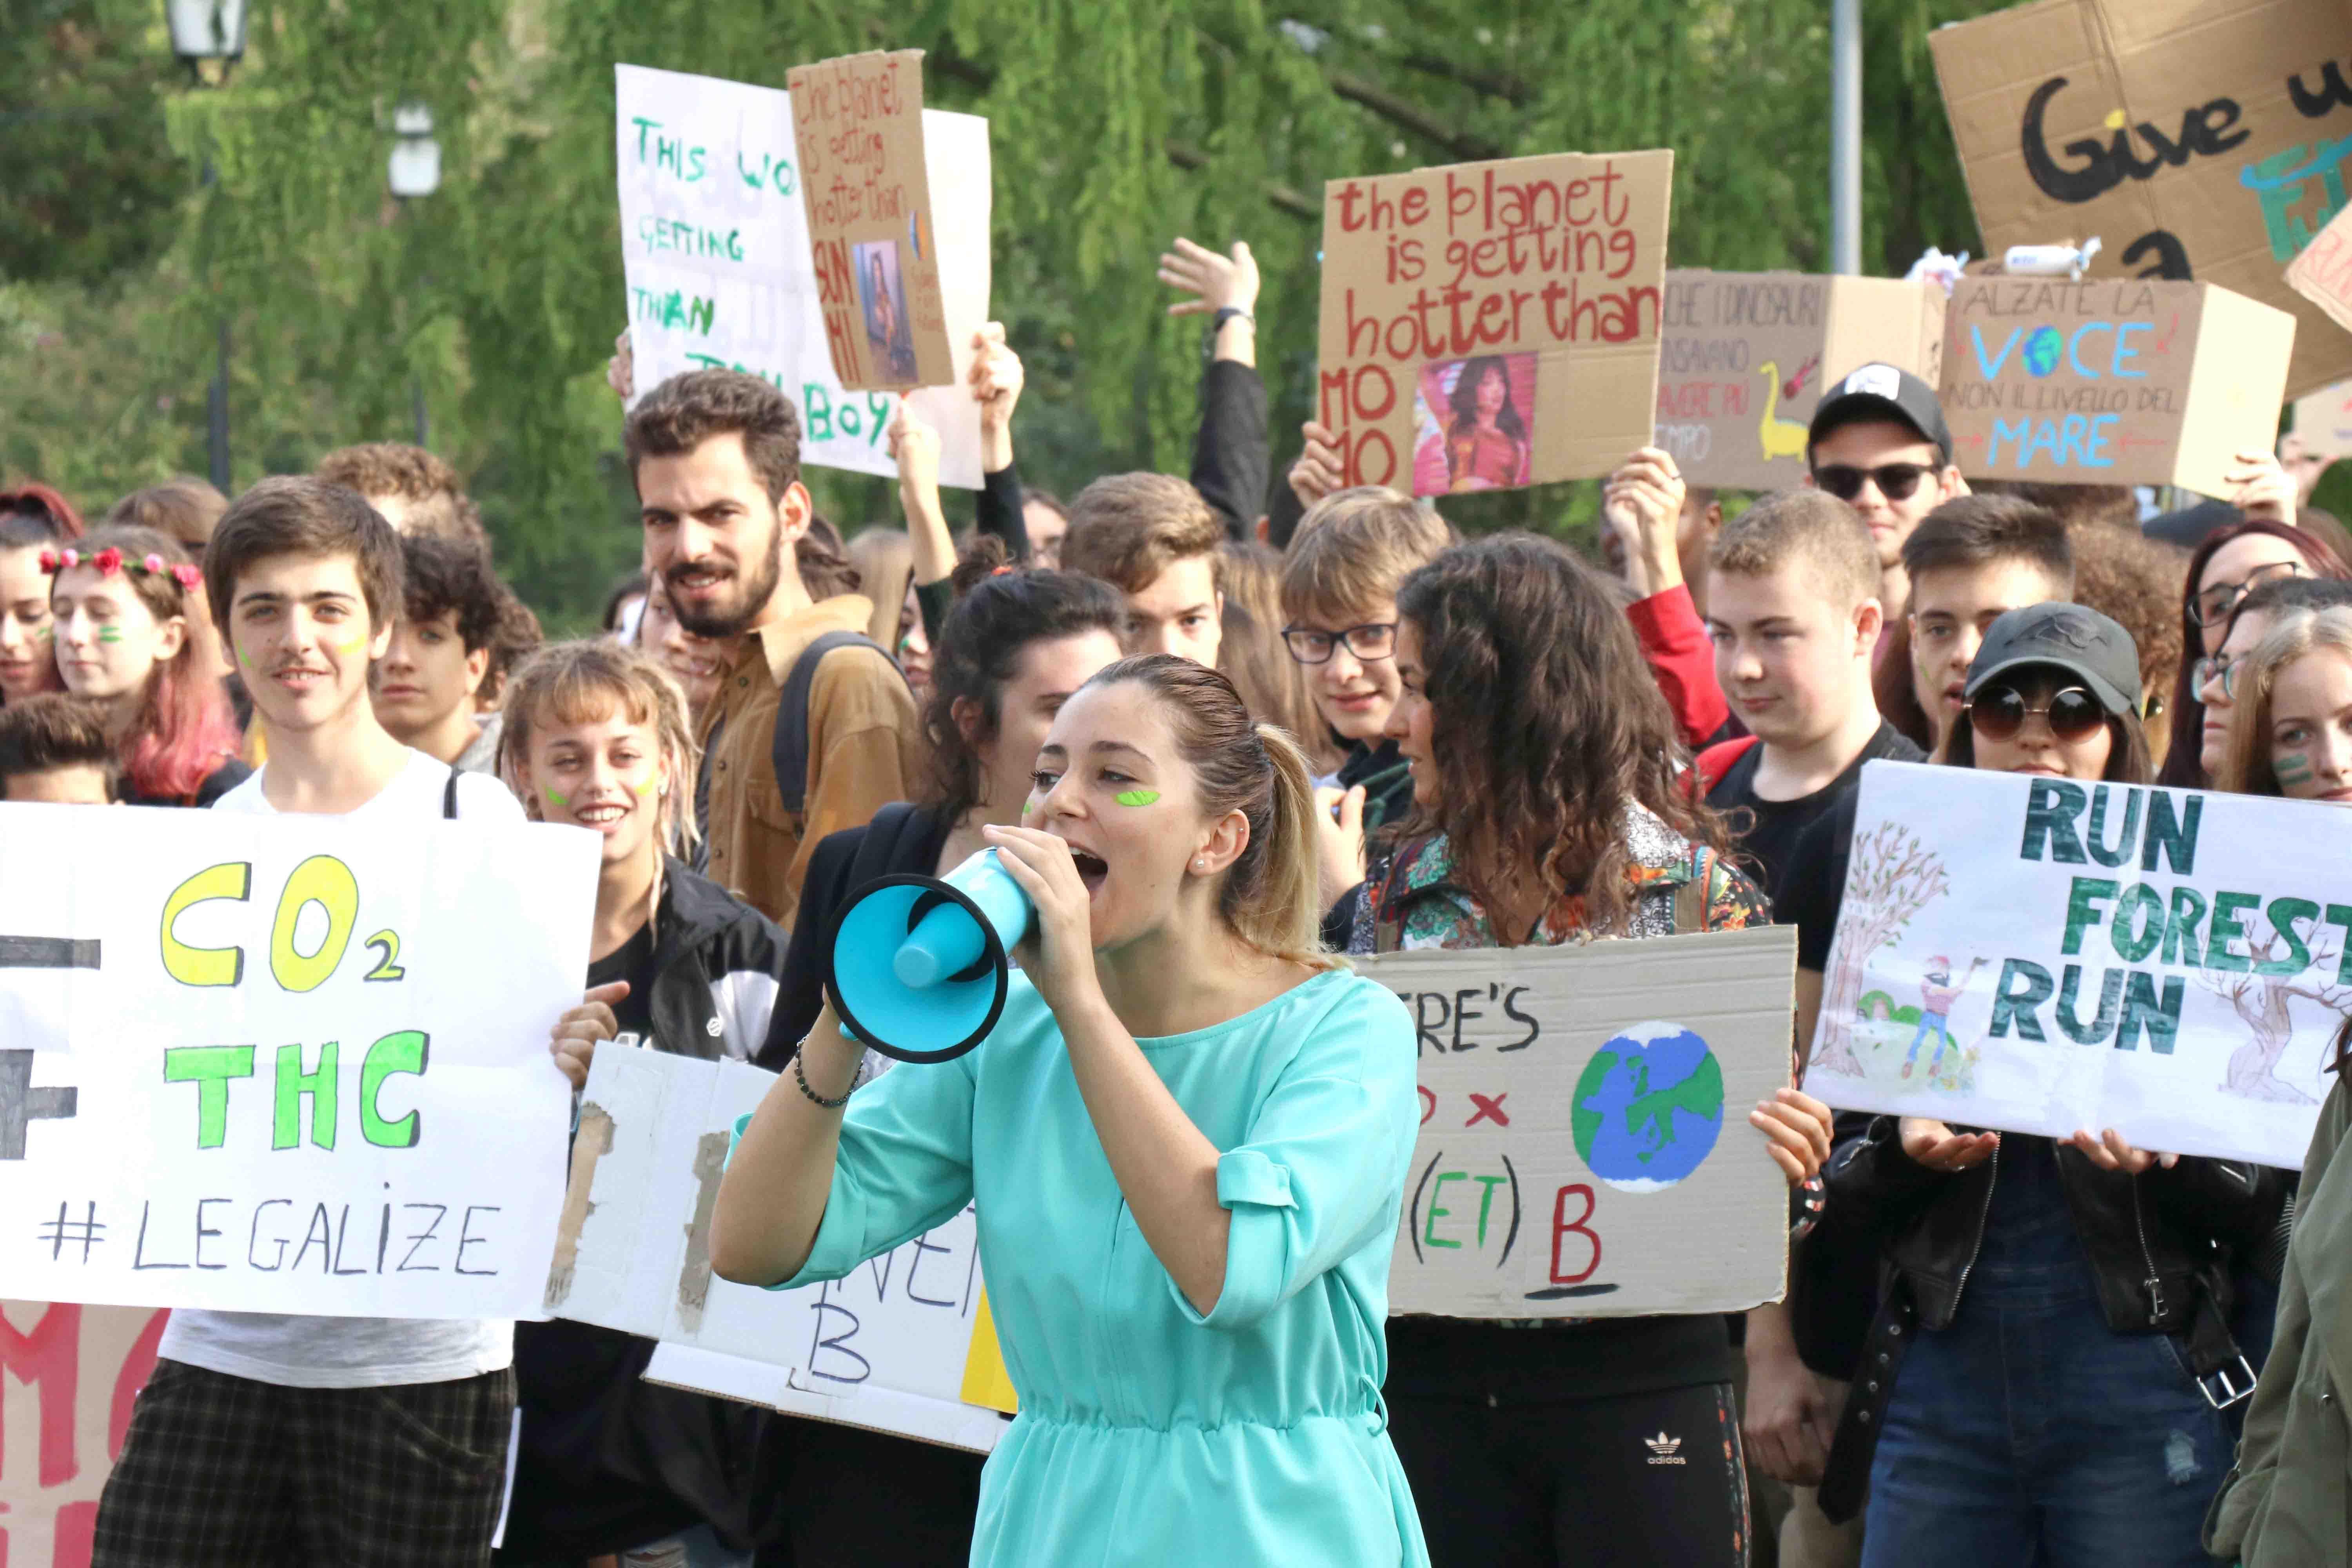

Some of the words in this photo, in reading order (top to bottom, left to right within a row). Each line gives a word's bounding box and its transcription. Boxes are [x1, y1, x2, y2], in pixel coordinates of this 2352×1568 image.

[632, 116, 706, 182] THIS
[2022, 76, 2251, 204] Give
[1332, 182, 1430, 232] the
[1447, 161, 1629, 235] planet
[639, 215, 744, 262] GETTING
[1387, 234, 1426, 284] is
[1439, 224, 1637, 291] getting
[1962, 282, 2096, 316] ALZATE
[2116, 283, 2155, 315] LA
[1320, 363, 1397, 431] MO
[1945, 383, 2004, 409] NON
[2011, 383, 2031, 409] IL
[2035, 385, 2129, 413] LIVELLO
[2137, 386, 2178, 414] DEL
[1987, 413, 2120, 467] MARE
[2020, 778, 2203, 876] RUN
[2061, 877, 2352, 985] FOREST
[1395, 982, 1540, 1058] RE'S
[1989, 958, 2185, 1054] RUN
[163, 1030, 430, 1151] THC
[808, 1301, 871, 1384] B
[1648, 1456, 1686, 1465] adidas
